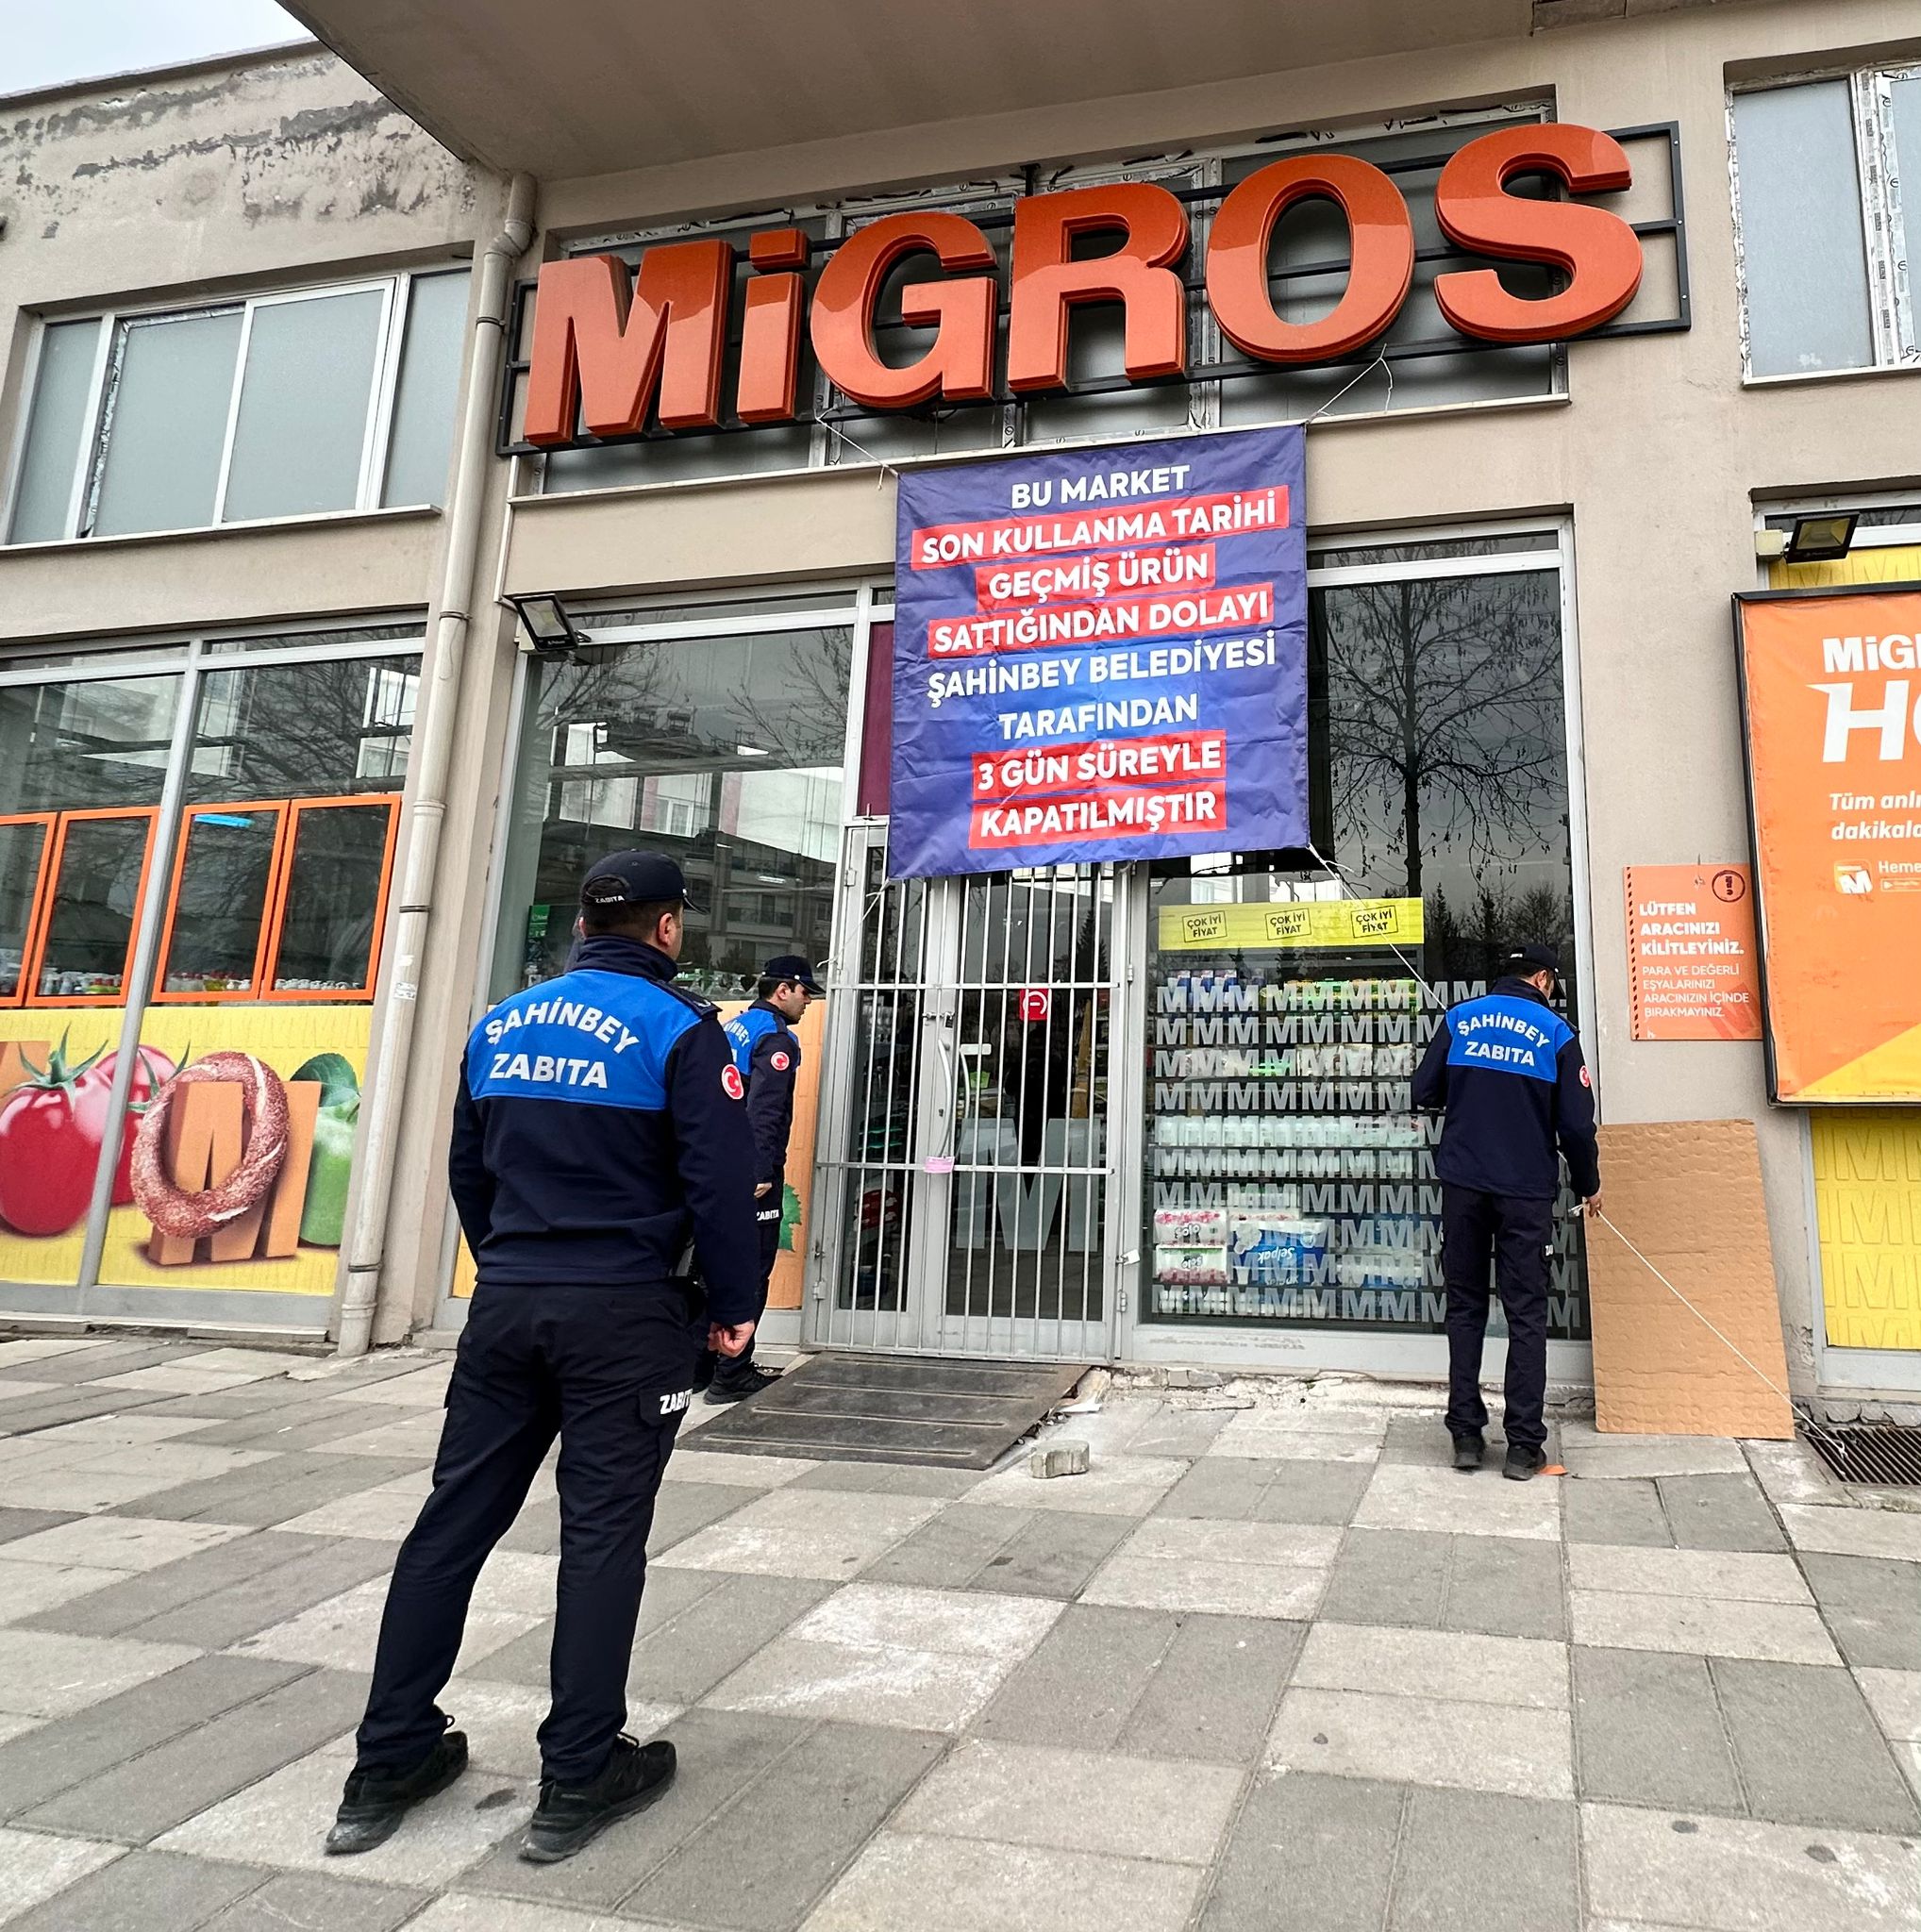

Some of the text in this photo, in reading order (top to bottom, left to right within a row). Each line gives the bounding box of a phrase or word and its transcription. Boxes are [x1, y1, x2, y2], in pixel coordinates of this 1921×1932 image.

[1011, 464, 1191, 509] BU MARKET
[921, 490, 1277, 564] SON KULLANMA TARİHİ
[989, 548, 1209, 605] GEÇMİŞ ÜRÜN
[933, 591, 1268, 654] SATTIĞINDAN DOLAYI
[927, 629, 1277, 709] ŞAHİNBEY BELEDİYESİ
[999, 693, 1198, 741] TARAFINDAN
[1805, 679, 1921, 763] H
[977, 740, 1221, 791] 3 GÜN SÜREYLE
[980, 791, 1217, 838] KAPATILMIŞTIR
[1829, 792, 1876, 811] Tüm
[1186, 913, 1223, 929] ÇOK İYİ
[1269, 911, 1306, 927] ÇOK İYİ
[1355, 908, 1393, 925] ÇOK İYİ
[1639, 902, 1696, 917] LÜTFEN
[1193, 925, 1218, 939] FİYAT
[1276, 924, 1302, 936] FİYAT
[1641, 923, 1721, 937] ARACINIZI
[1641, 939, 1746, 957] KİLİTLEYİNİZ.
[1642, 963, 1740, 975] PARA VE DEĞERLİ
[1643, 979, 1715, 991] EŞYALARINIZI
[1644, 991, 1749, 1005] ARACINIZIN İÇİNDE
[484, 995, 641, 1056] ŞAHİNBEY
[1645, 1007, 1726, 1018] BIRAKMAYINIZ.
[1457, 1011, 1551, 1049] ŞAHİNBEY
[1464, 1041, 1536, 1067] ZABITA
[489, 1052, 609, 1090] ZABITA
[660, 1388, 693, 1415] ZABIT
